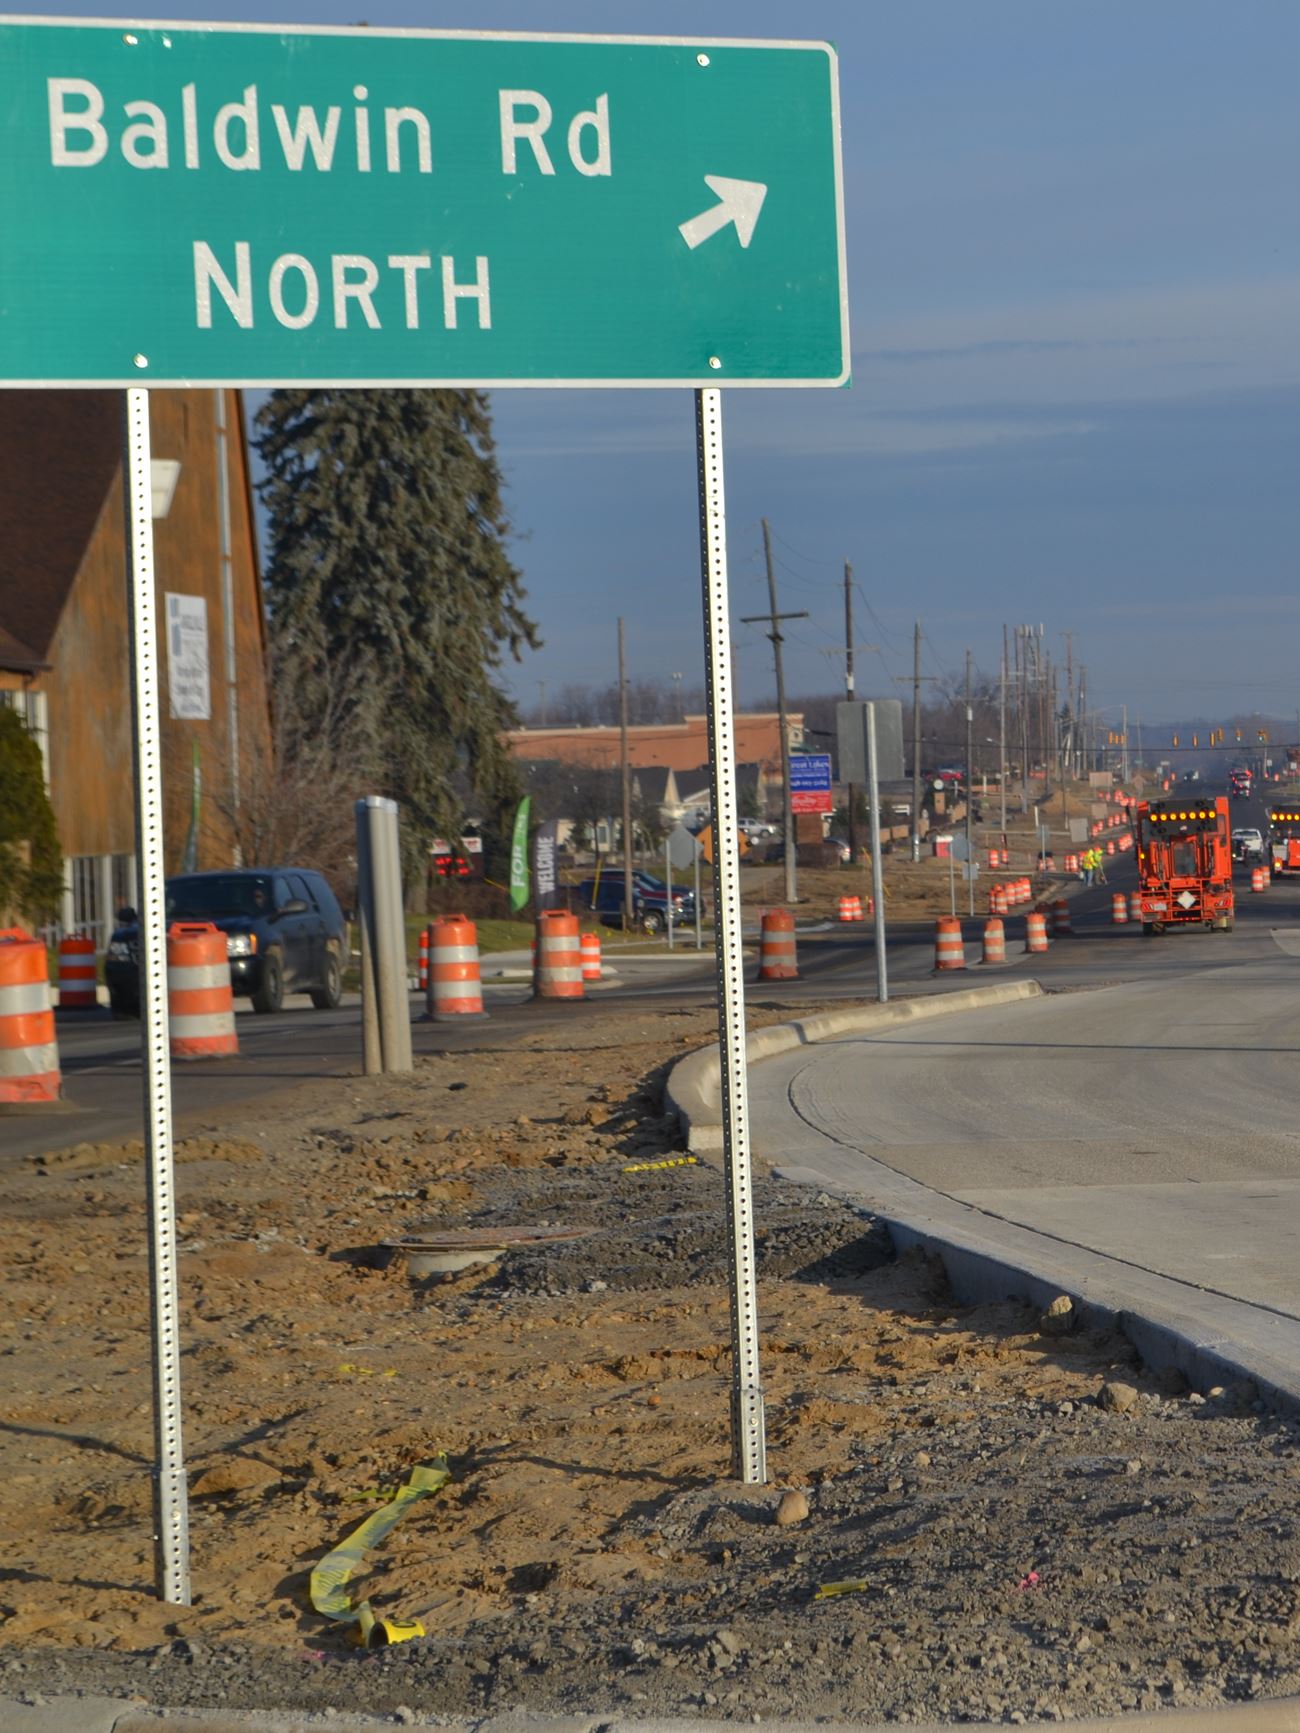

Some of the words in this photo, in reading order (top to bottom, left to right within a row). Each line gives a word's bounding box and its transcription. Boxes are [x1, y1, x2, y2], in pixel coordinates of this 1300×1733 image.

[47, 77, 433, 173] Baldwin
[498, 88, 613, 177] Rd
[193, 240, 492, 330] NORTH
[512, 846, 525, 887] FOR
[537, 836, 555, 894] WELCOME
